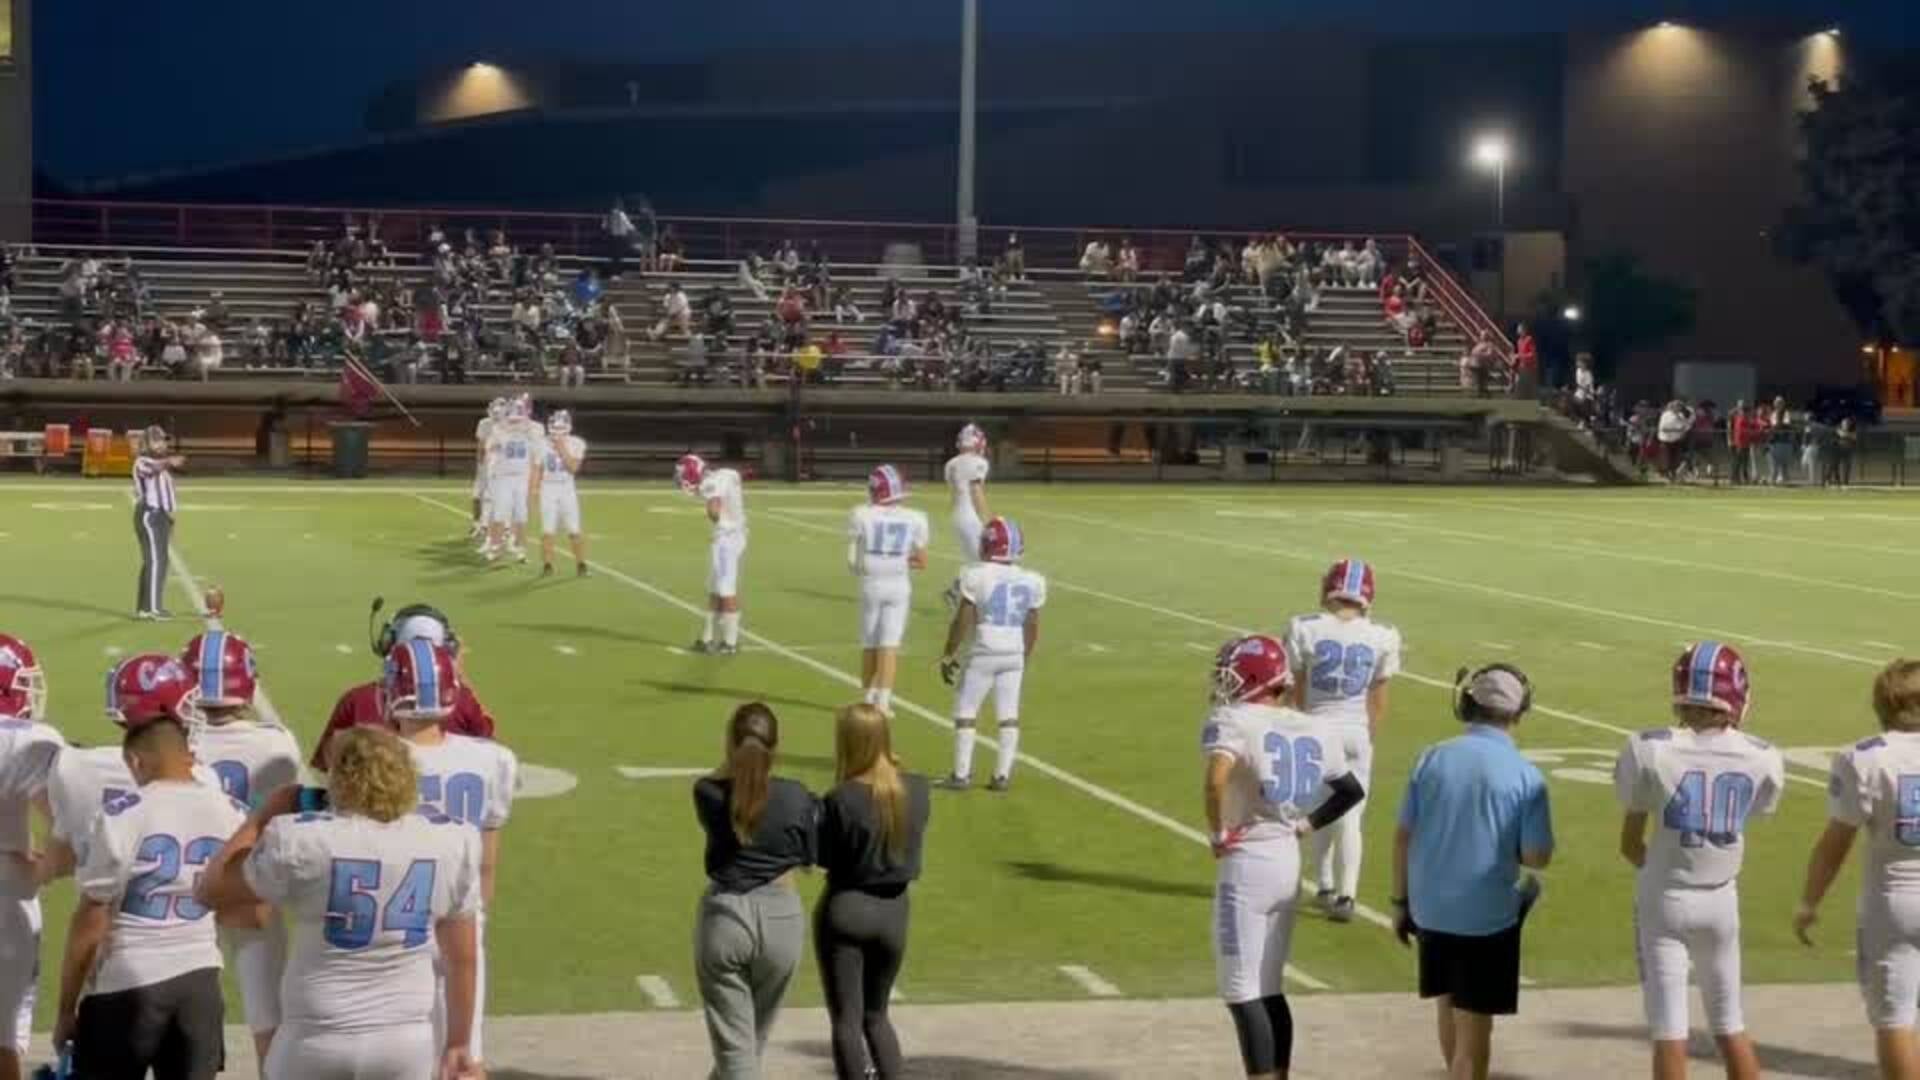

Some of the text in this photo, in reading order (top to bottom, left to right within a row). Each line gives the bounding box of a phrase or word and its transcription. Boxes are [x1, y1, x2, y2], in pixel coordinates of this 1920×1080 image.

[867, 520, 908, 556] 17
[1311, 639, 1376, 697] 29
[1263, 731, 1324, 806] 36
[1663, 770, 1756, 848] 40
[323, 857, 437, 950] 54
